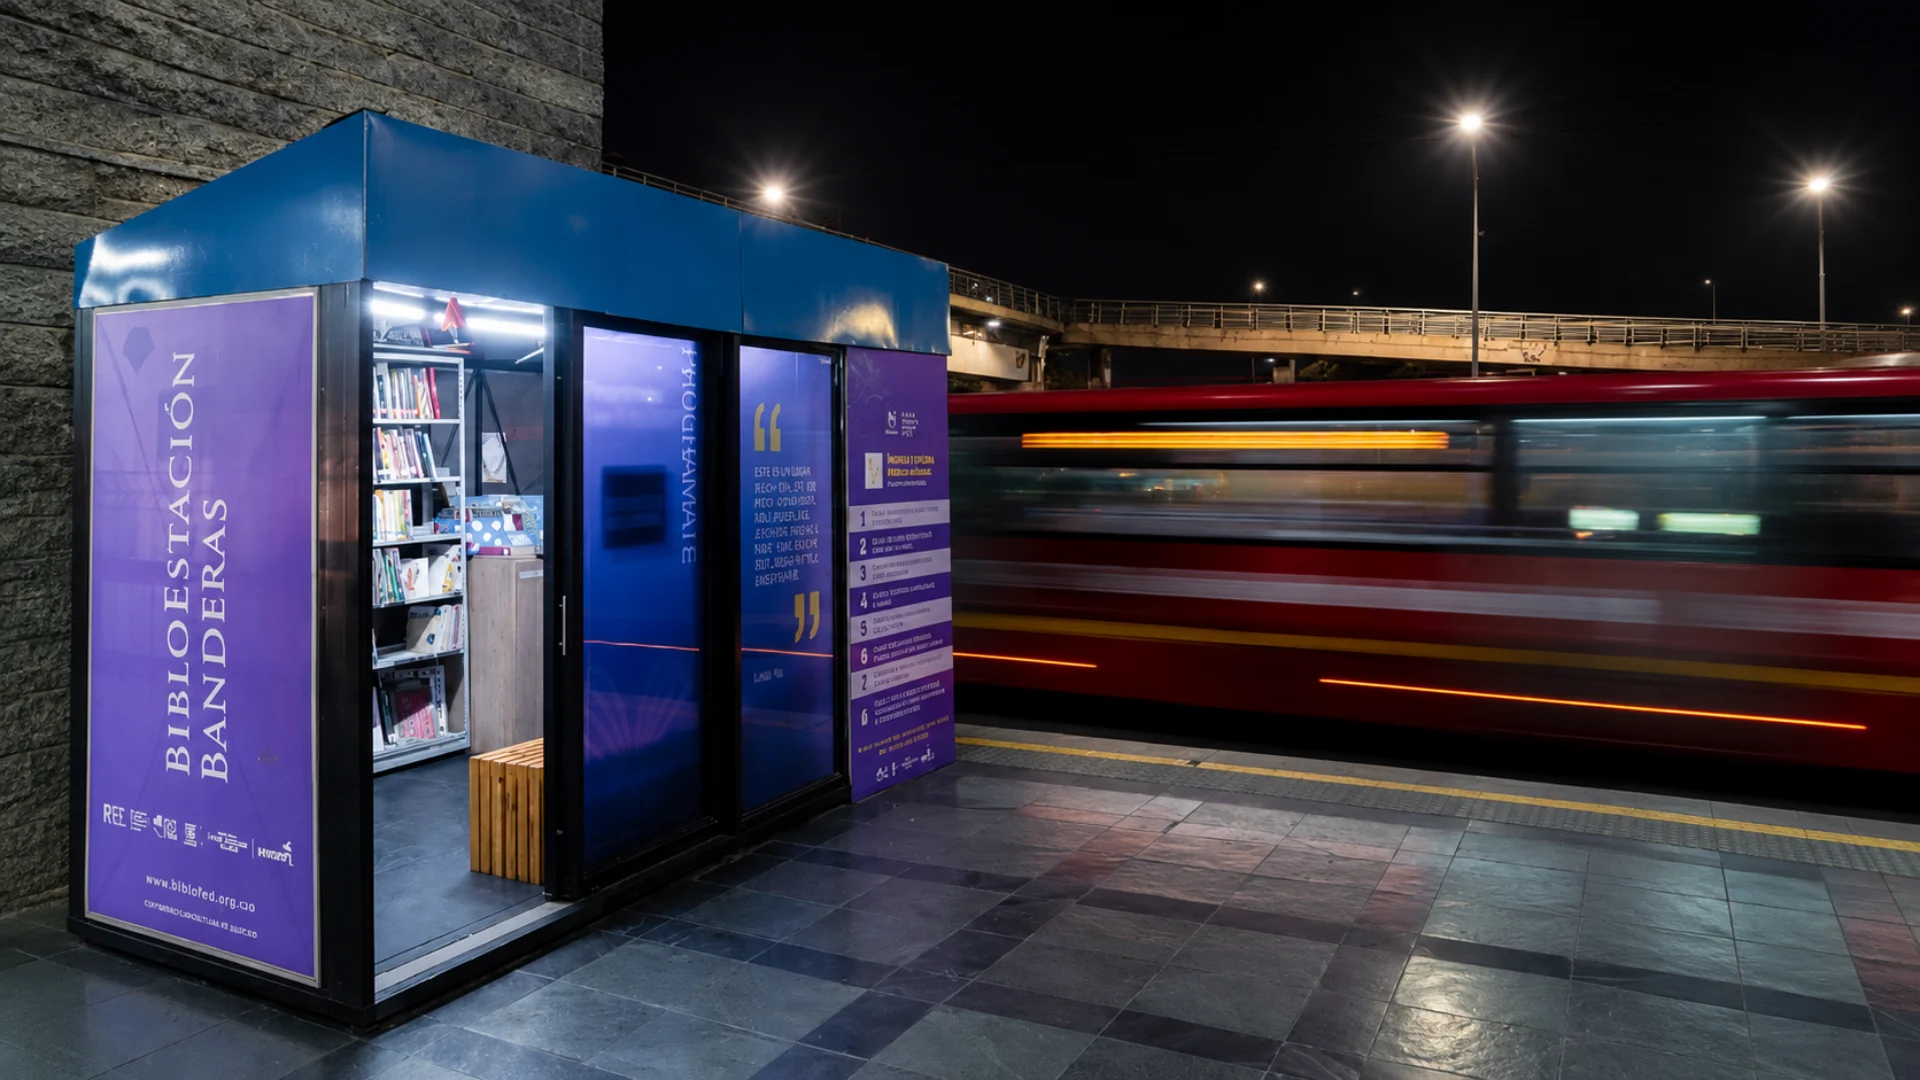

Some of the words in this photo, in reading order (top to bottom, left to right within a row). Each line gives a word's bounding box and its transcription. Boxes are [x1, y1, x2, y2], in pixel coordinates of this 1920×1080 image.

[860, 510, 866, 527] 1
[859, 537, 867, 556] 2
[860, 565, 867, 581] 3
[860, 592, 868, 609] 4
[202, 498, 229, 784] BANDERAS
[860, 648, 868, 664] 6
